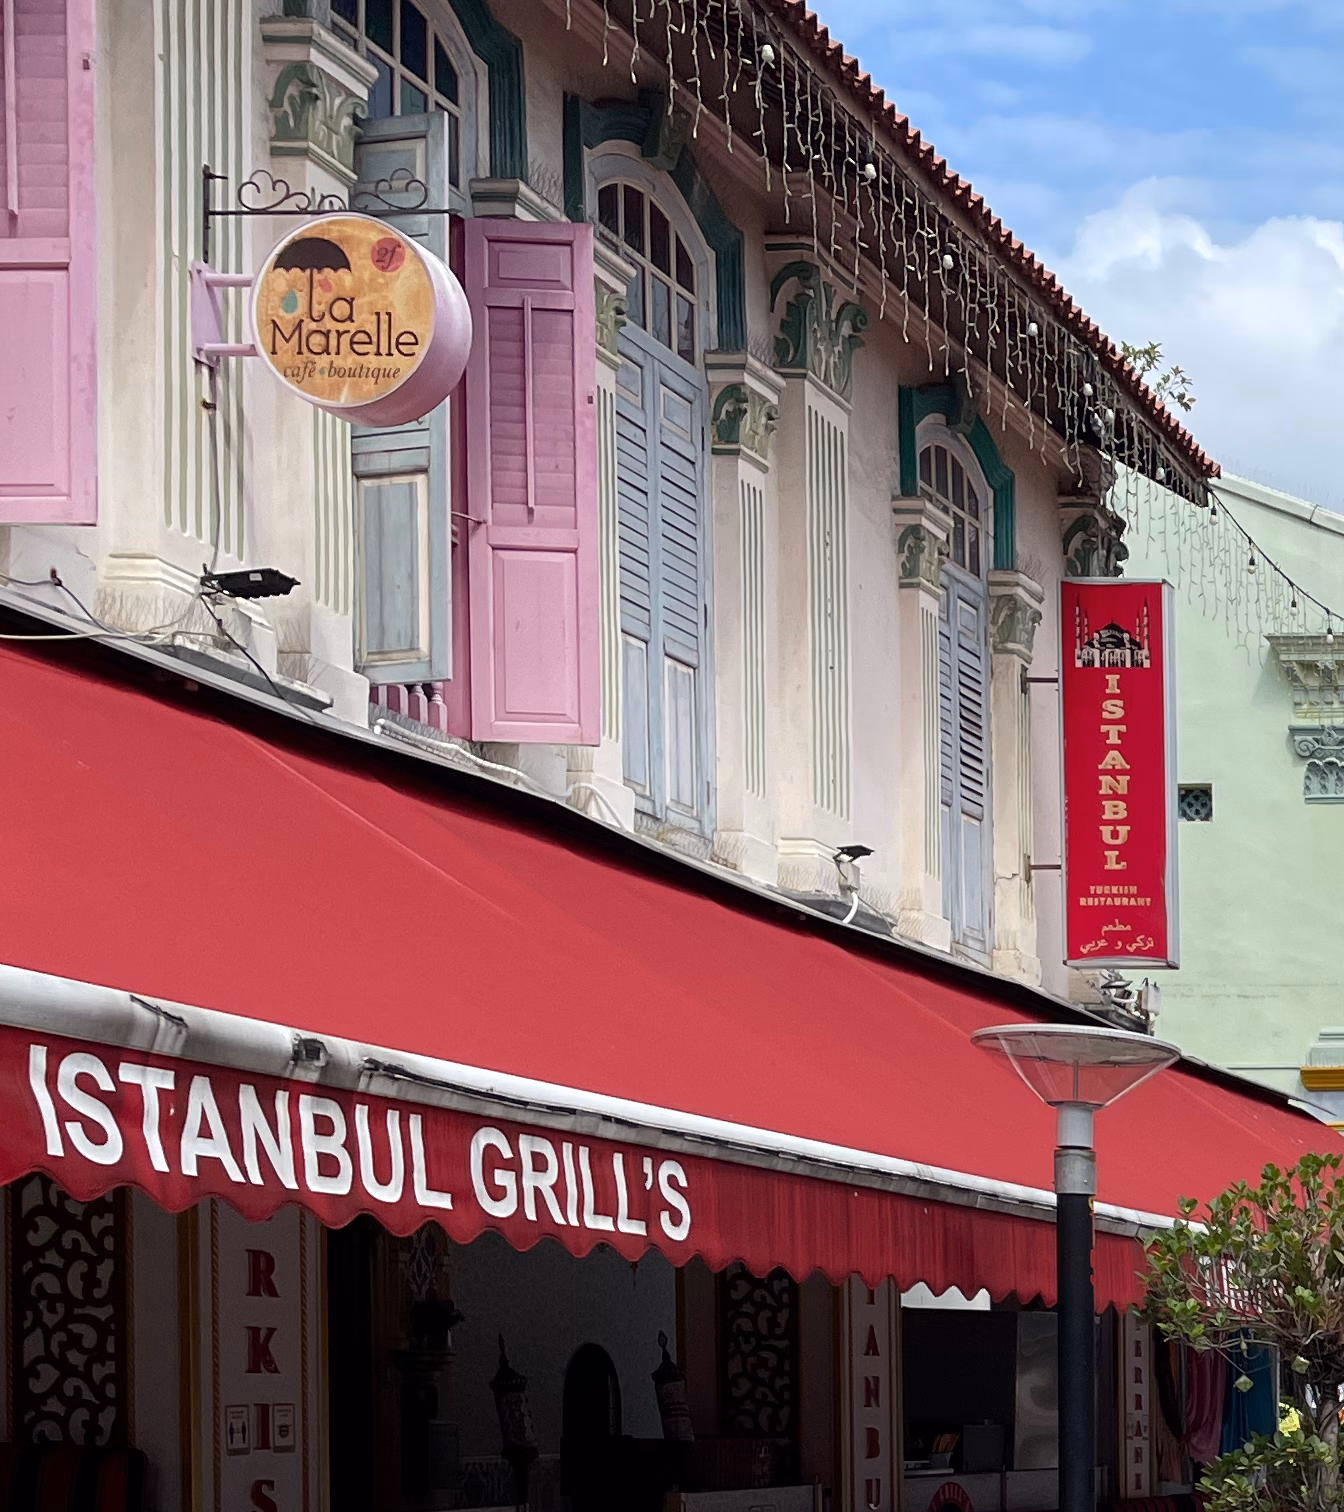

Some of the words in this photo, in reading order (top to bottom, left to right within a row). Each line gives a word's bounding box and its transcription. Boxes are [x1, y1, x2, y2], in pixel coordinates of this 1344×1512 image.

[270, 311, 420, 358] Marelle
[283, 359, 317, 385] café
[327, 362, 401, 385] boutique
[1097, 673, 1131, 871] ISTANBUL
[1089, 885, 1138, 895] TURKISH
[1079, 897, 1152, 907] RESTAURANT
[1101, 918, 1132, 937] مطعم
[1079, 938, 1109, 955] عربي
[1114, 939, 1123, 950] و
[1125, 934, 1155, 953] تركي
[28, 1043, 453, 1211] ISTANBUL
[468, 1126, 692, 1242] GRILL'S
